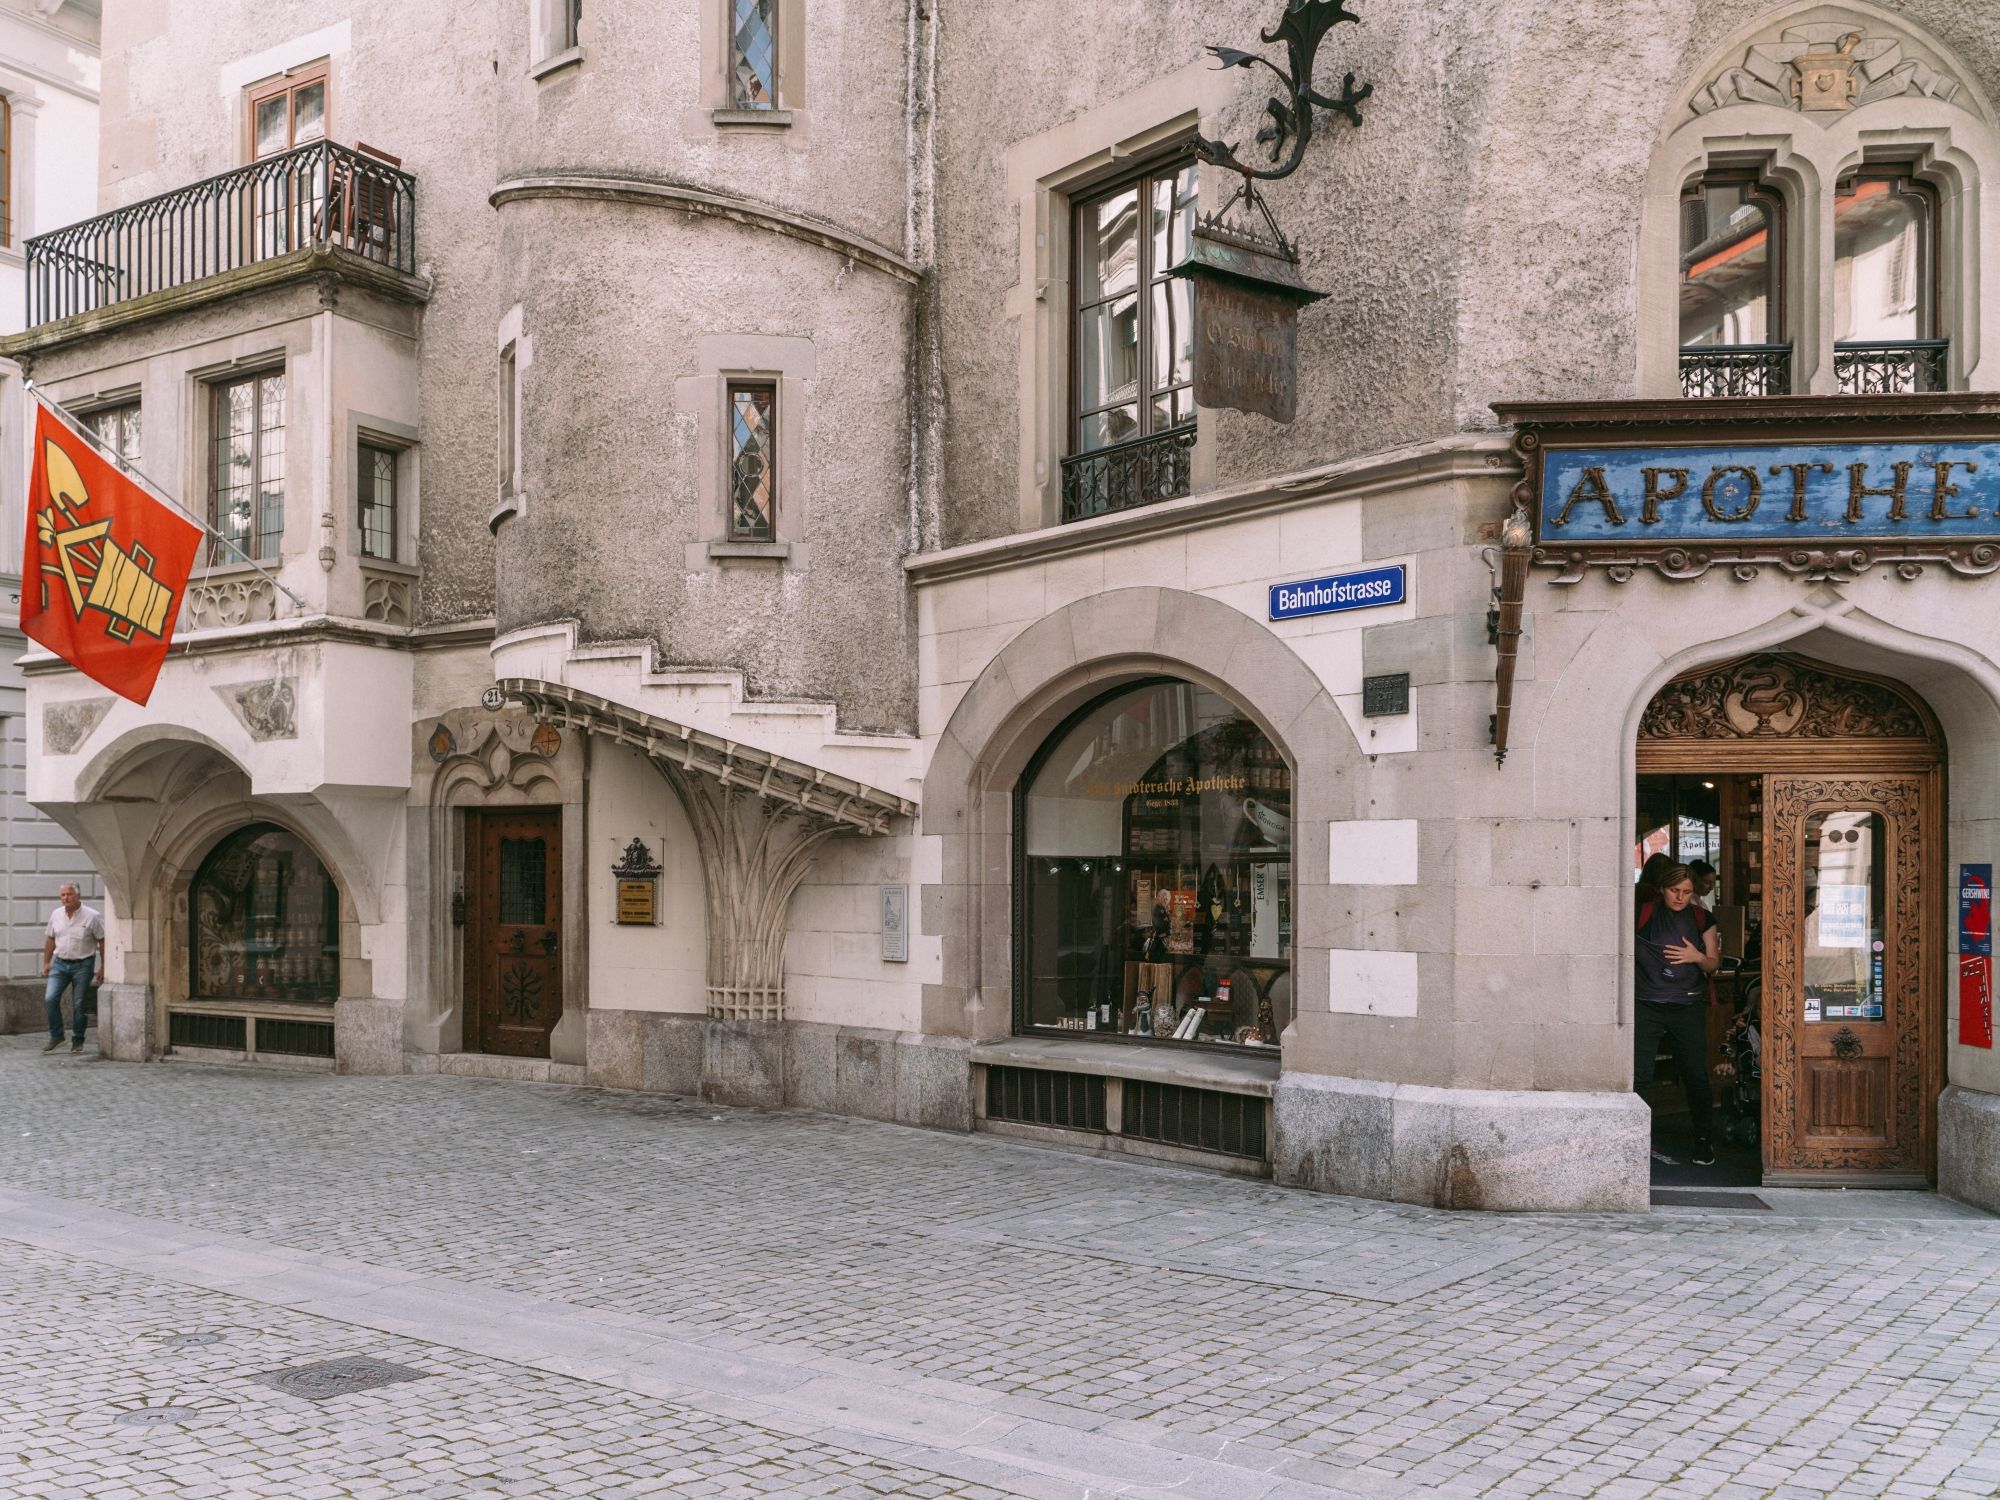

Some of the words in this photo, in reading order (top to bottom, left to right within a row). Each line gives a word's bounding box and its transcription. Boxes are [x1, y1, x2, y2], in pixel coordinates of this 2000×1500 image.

[1549, 460, 2000, 527] APOTHE
[1279, 579, 1392, 611] Bahnhofstrasse
[488, 691, 498, 703] 21
[1186, 775, 1245, 795] Apotheke
[1962, 888, 1990, 899] GERSHWIN!
